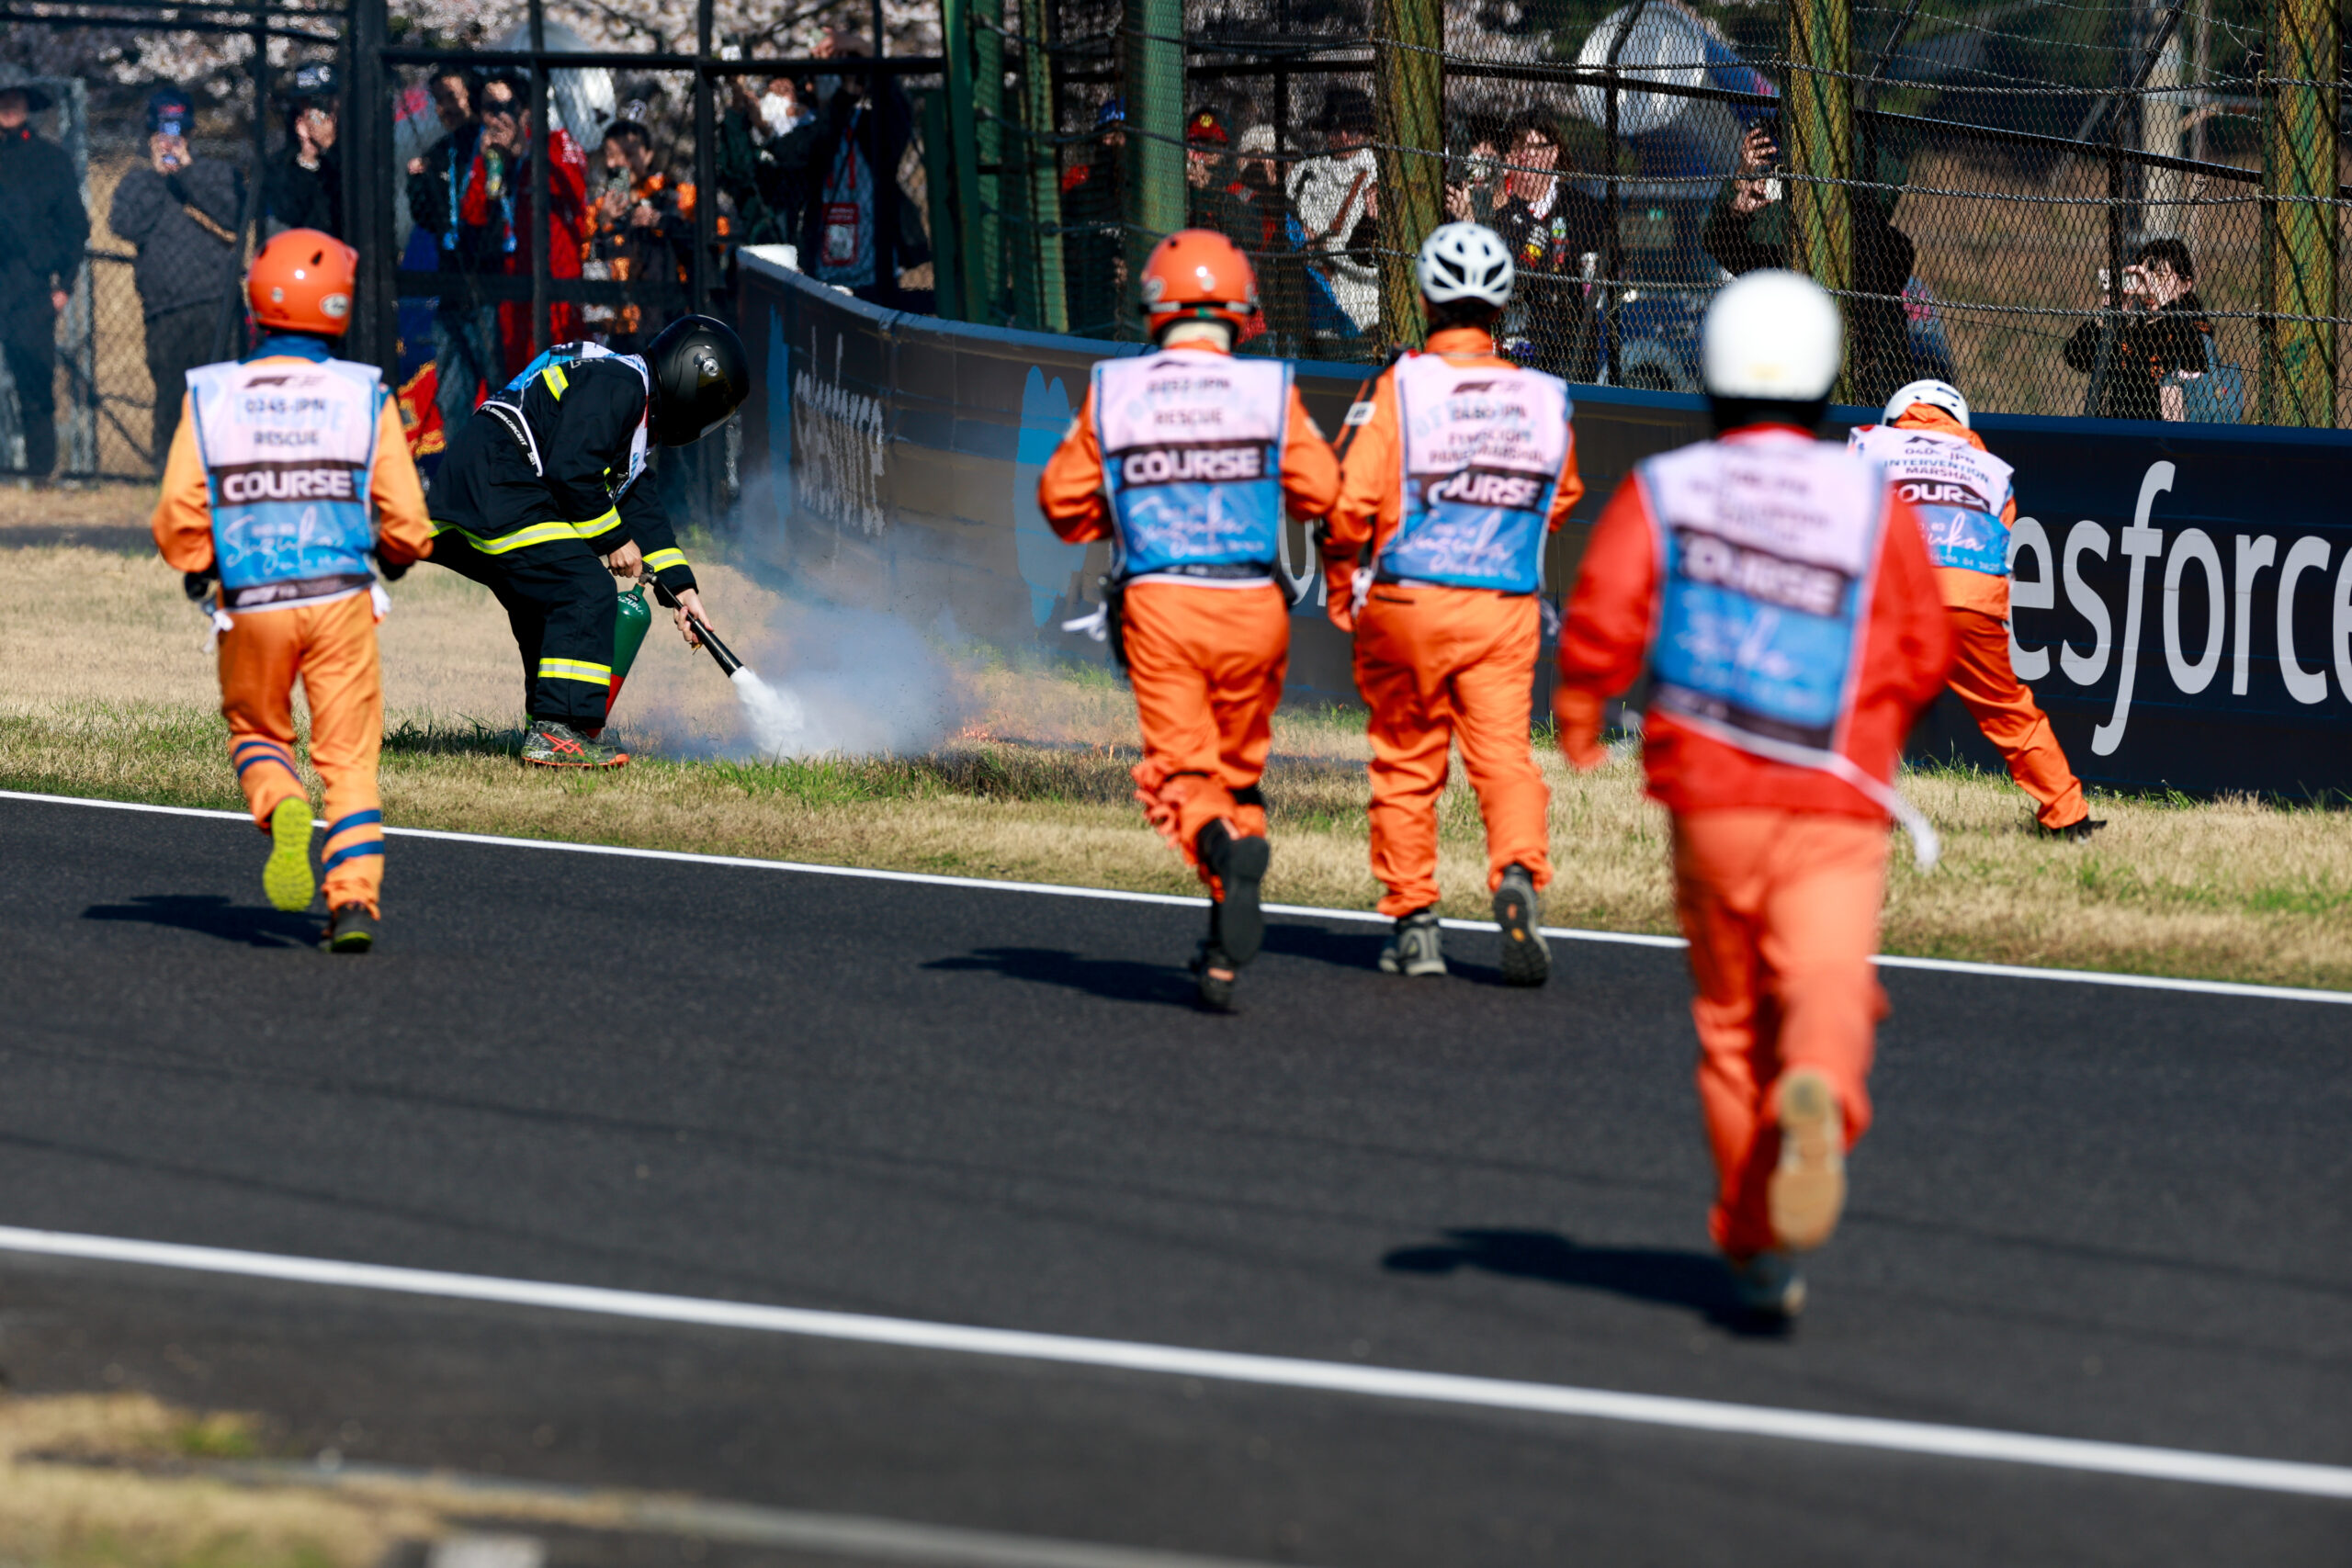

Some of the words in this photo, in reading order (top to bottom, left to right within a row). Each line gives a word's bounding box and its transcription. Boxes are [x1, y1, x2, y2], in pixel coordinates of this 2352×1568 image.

[1123, 446, 1261, 484] COURSE
[1883, 459, 1989, 483] INTERVENTION
[222, 469, 353, 502] COURSE
[2009, 459, 2352, 756] esforc
